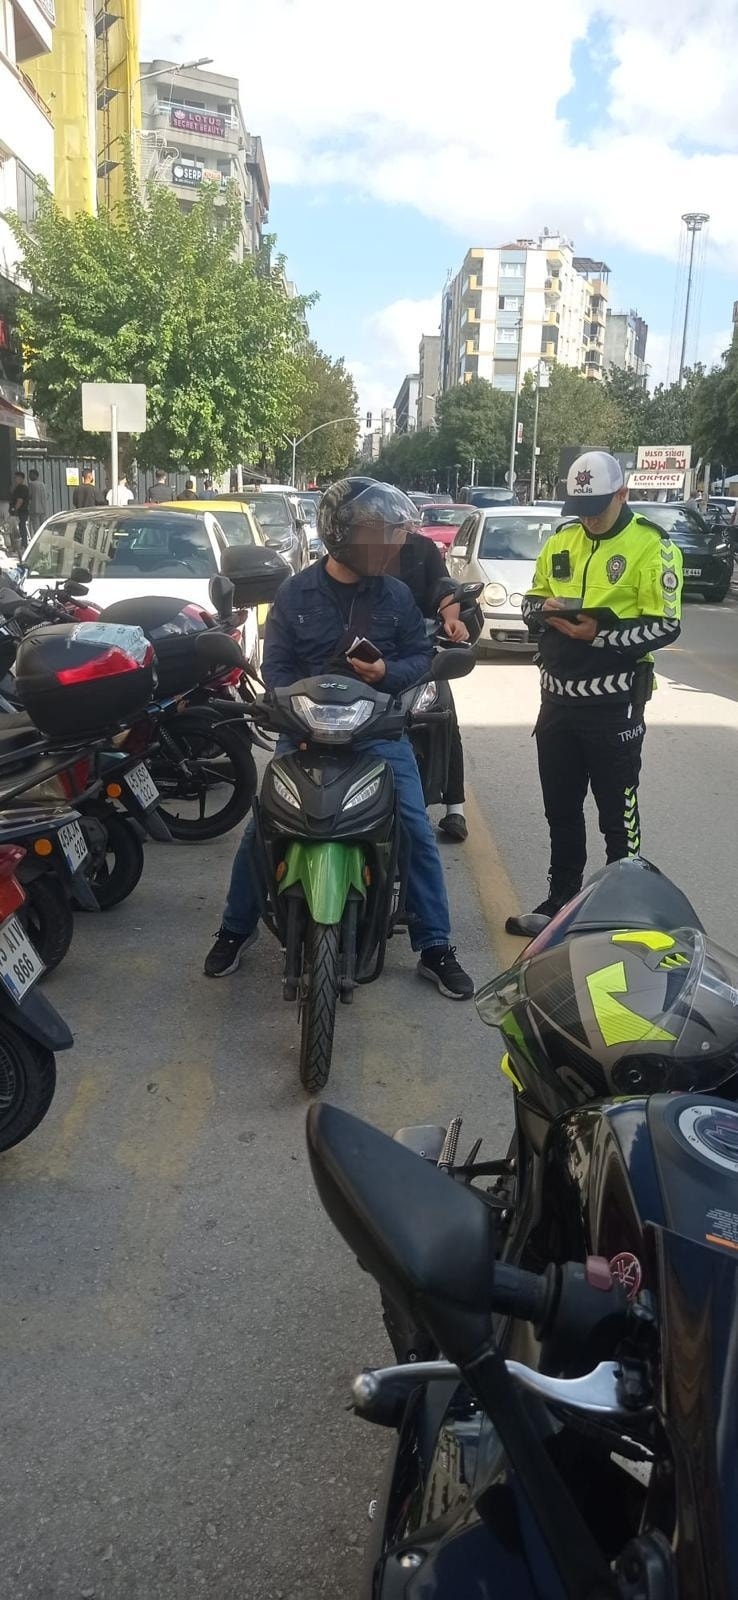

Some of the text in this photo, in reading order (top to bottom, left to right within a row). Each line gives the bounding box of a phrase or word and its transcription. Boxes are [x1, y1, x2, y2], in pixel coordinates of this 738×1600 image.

[174, 119, 224, 135] SECRET BEAUTY
[190, 113, 221, 127] LOTUS
[13, 952, 35, 985] 866
